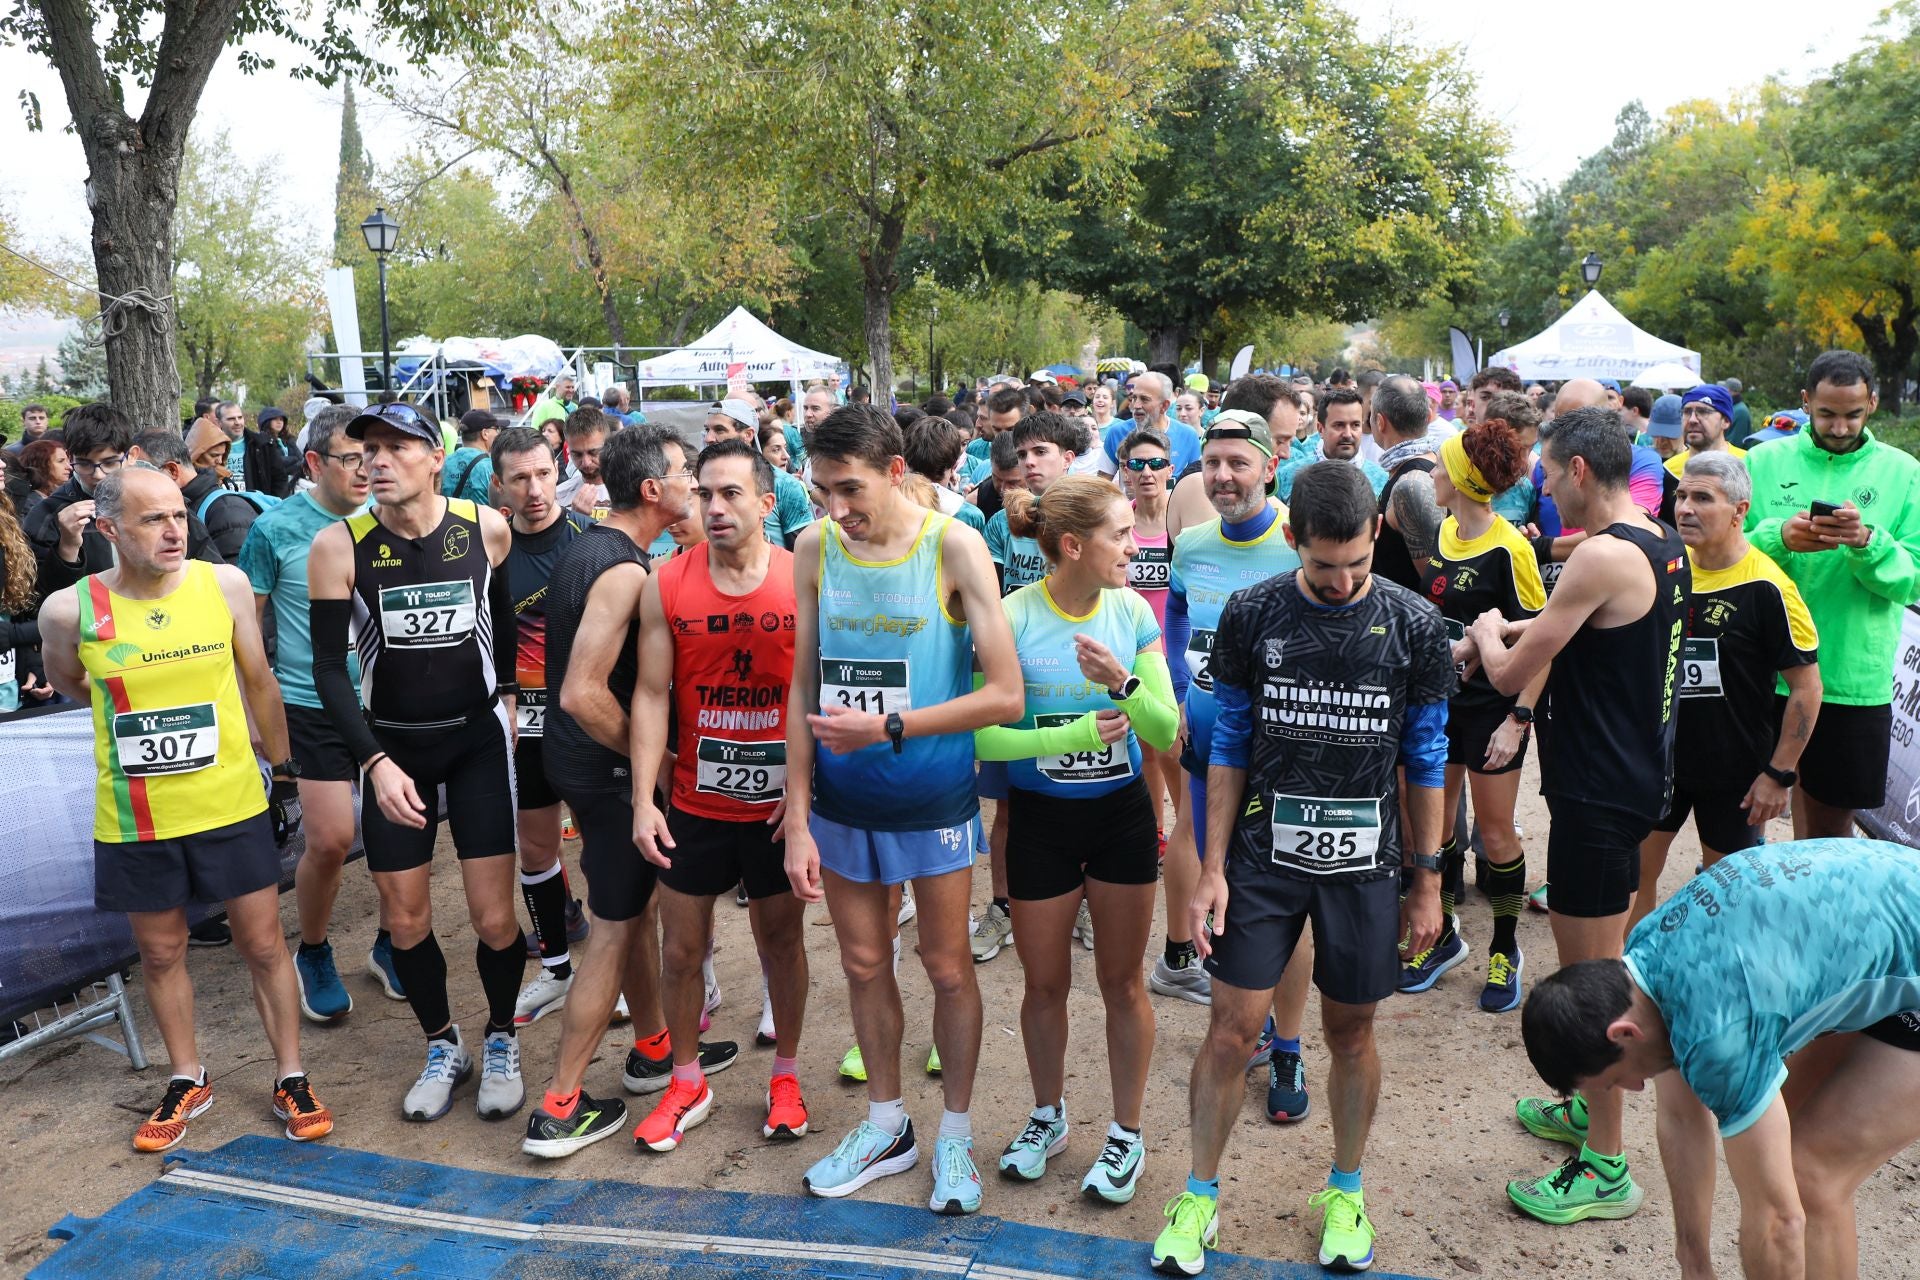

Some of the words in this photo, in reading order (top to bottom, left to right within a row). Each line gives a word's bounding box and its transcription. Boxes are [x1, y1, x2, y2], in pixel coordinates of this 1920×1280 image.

[1606, 369, 1641, 377] TOLED
[372, 558, 402, 568] VIATOR
[1190, 563, 1220, 574] CURVA
[1135, 564, 1168, 581] 329
[1240, 570, 1272, 581] BTOD
[424, 591, 451, 599] TOLEDO
[403, 608, 457, 636] 327
[141, 645, 191, 664] Unicaja
[192, 641, 225, 654] Banco
[1020, 657, 1060, 667] CURVA
[1308, 680, 1345, 689] 2023
[696, 685, 784, 708] THERION
[837, 689, 885, 716] 311
[1283, 701, 1367, 717] ESCALONA
[161, 714, 191, 723] TOLEDO
[697, 708, 780, 731] RUNNING
[1279, 728, 1309, 738] DIRECT
[1337, 736, 1367, 744] POWER
[139, 732, 197, 763] 307
[1058, 744, 1113, 769] 349
[716, 766, 769, 792] 229
[1295, 830, 1357, 860] 285
